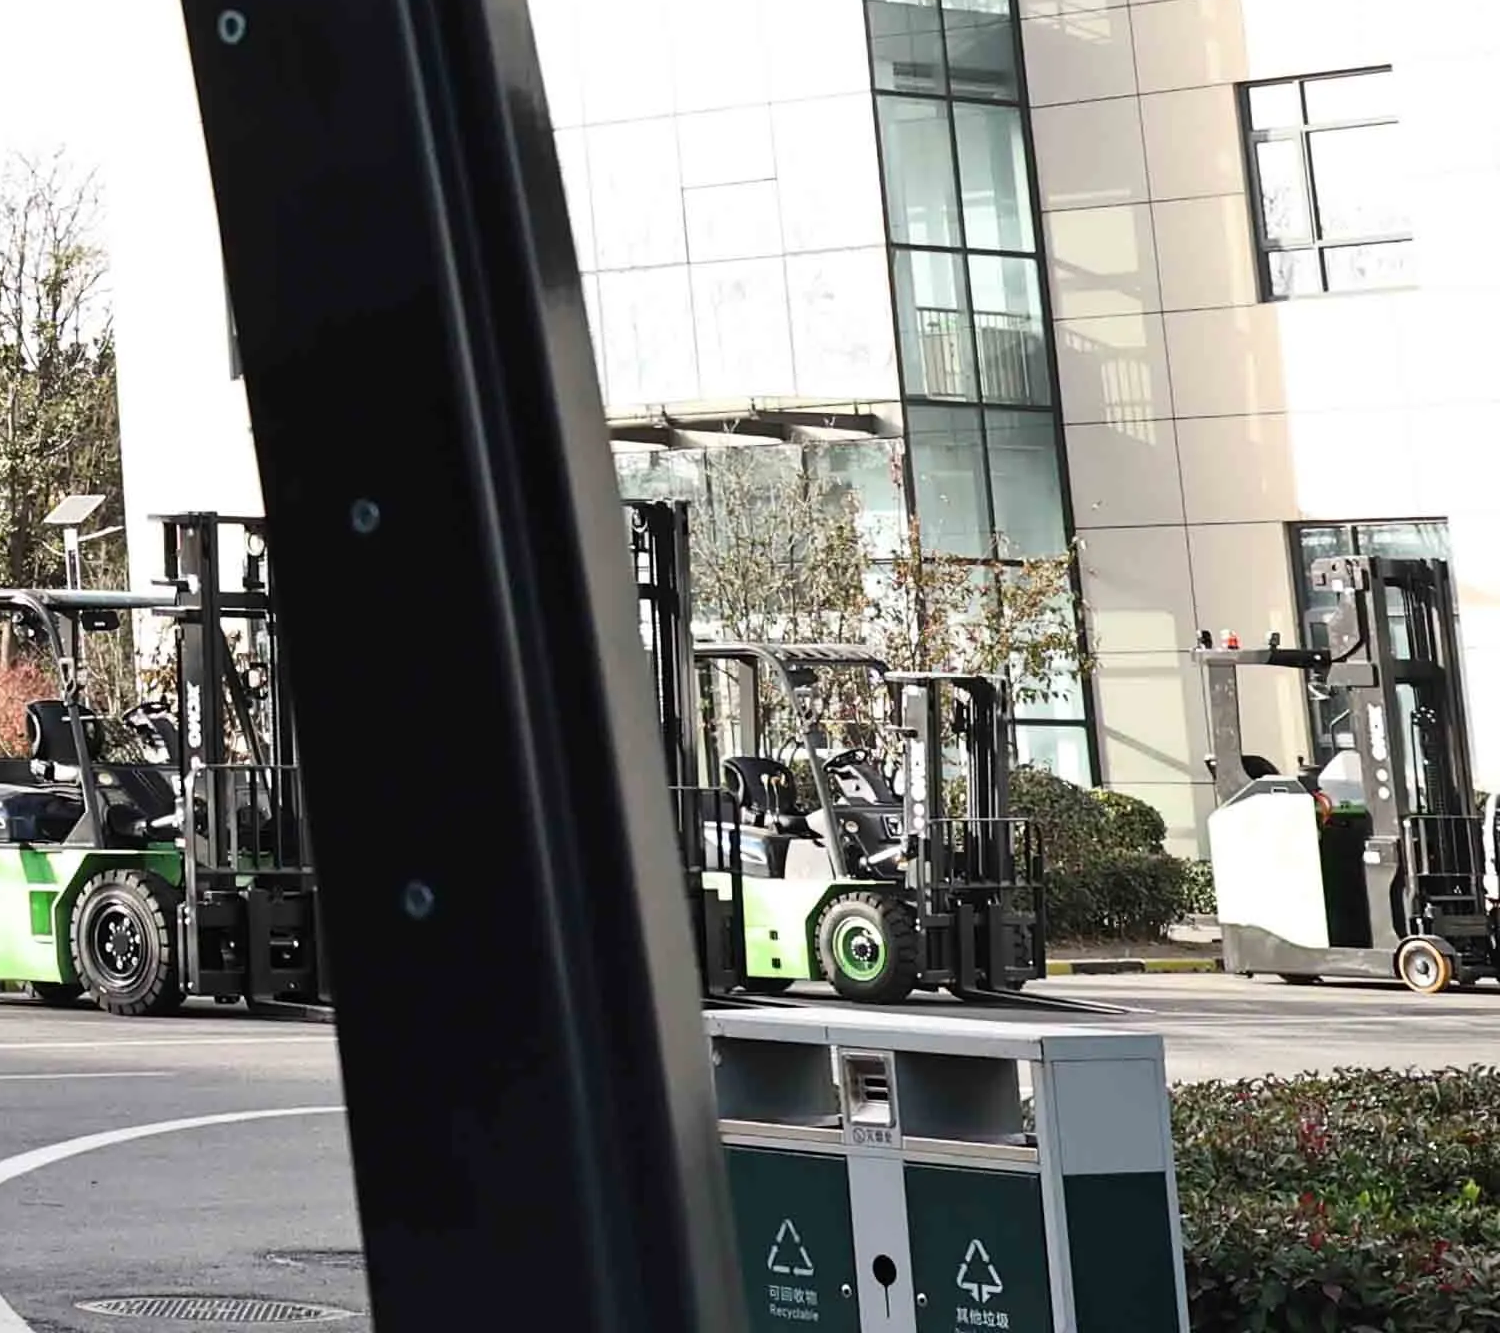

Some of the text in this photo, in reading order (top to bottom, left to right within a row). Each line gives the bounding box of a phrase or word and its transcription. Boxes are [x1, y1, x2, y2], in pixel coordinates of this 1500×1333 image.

[769, 1303, 819, 1322] Recyclable
[956, 1307, 1009, 1330] 其他垃圾
